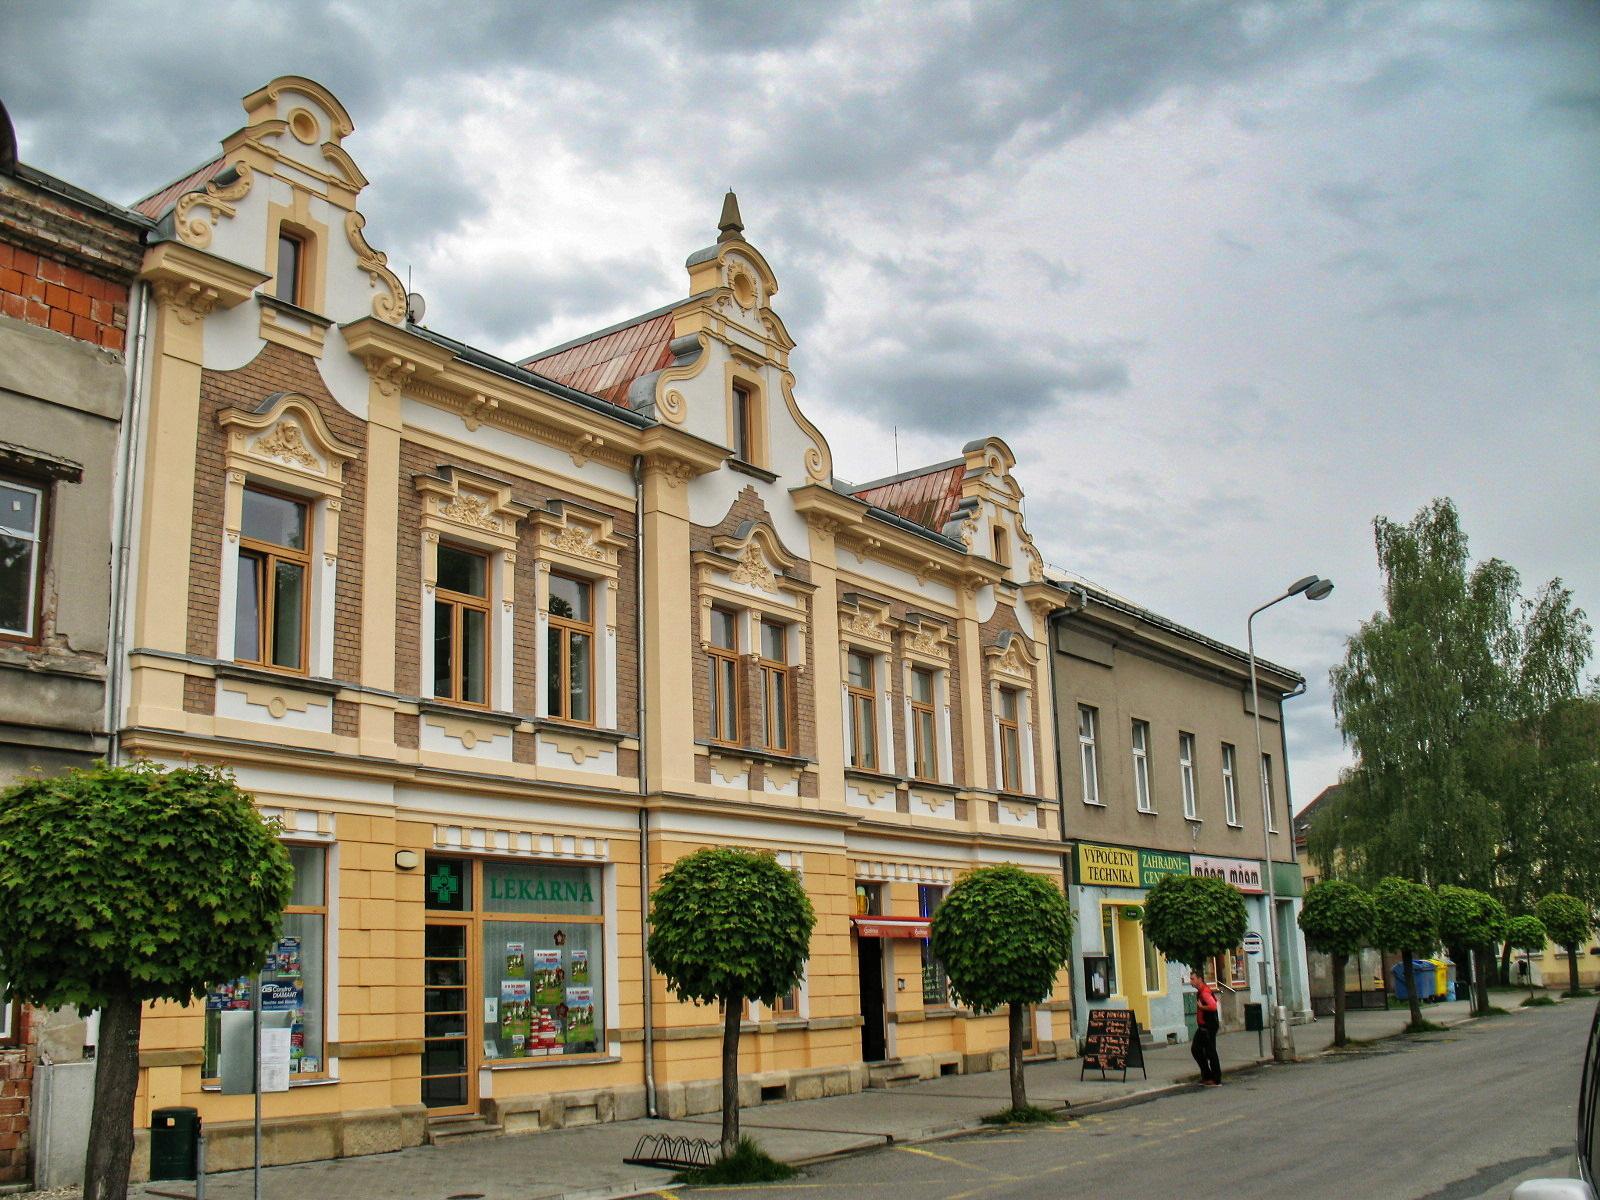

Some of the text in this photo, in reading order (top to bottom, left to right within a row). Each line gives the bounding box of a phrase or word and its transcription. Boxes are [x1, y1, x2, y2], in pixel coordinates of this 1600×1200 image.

[1088, 866, 1134, 884] TECHNIKA
[1229, 864, 1259, 885] mňam
[490, 871, 594, 902] LÉKÁRNA
